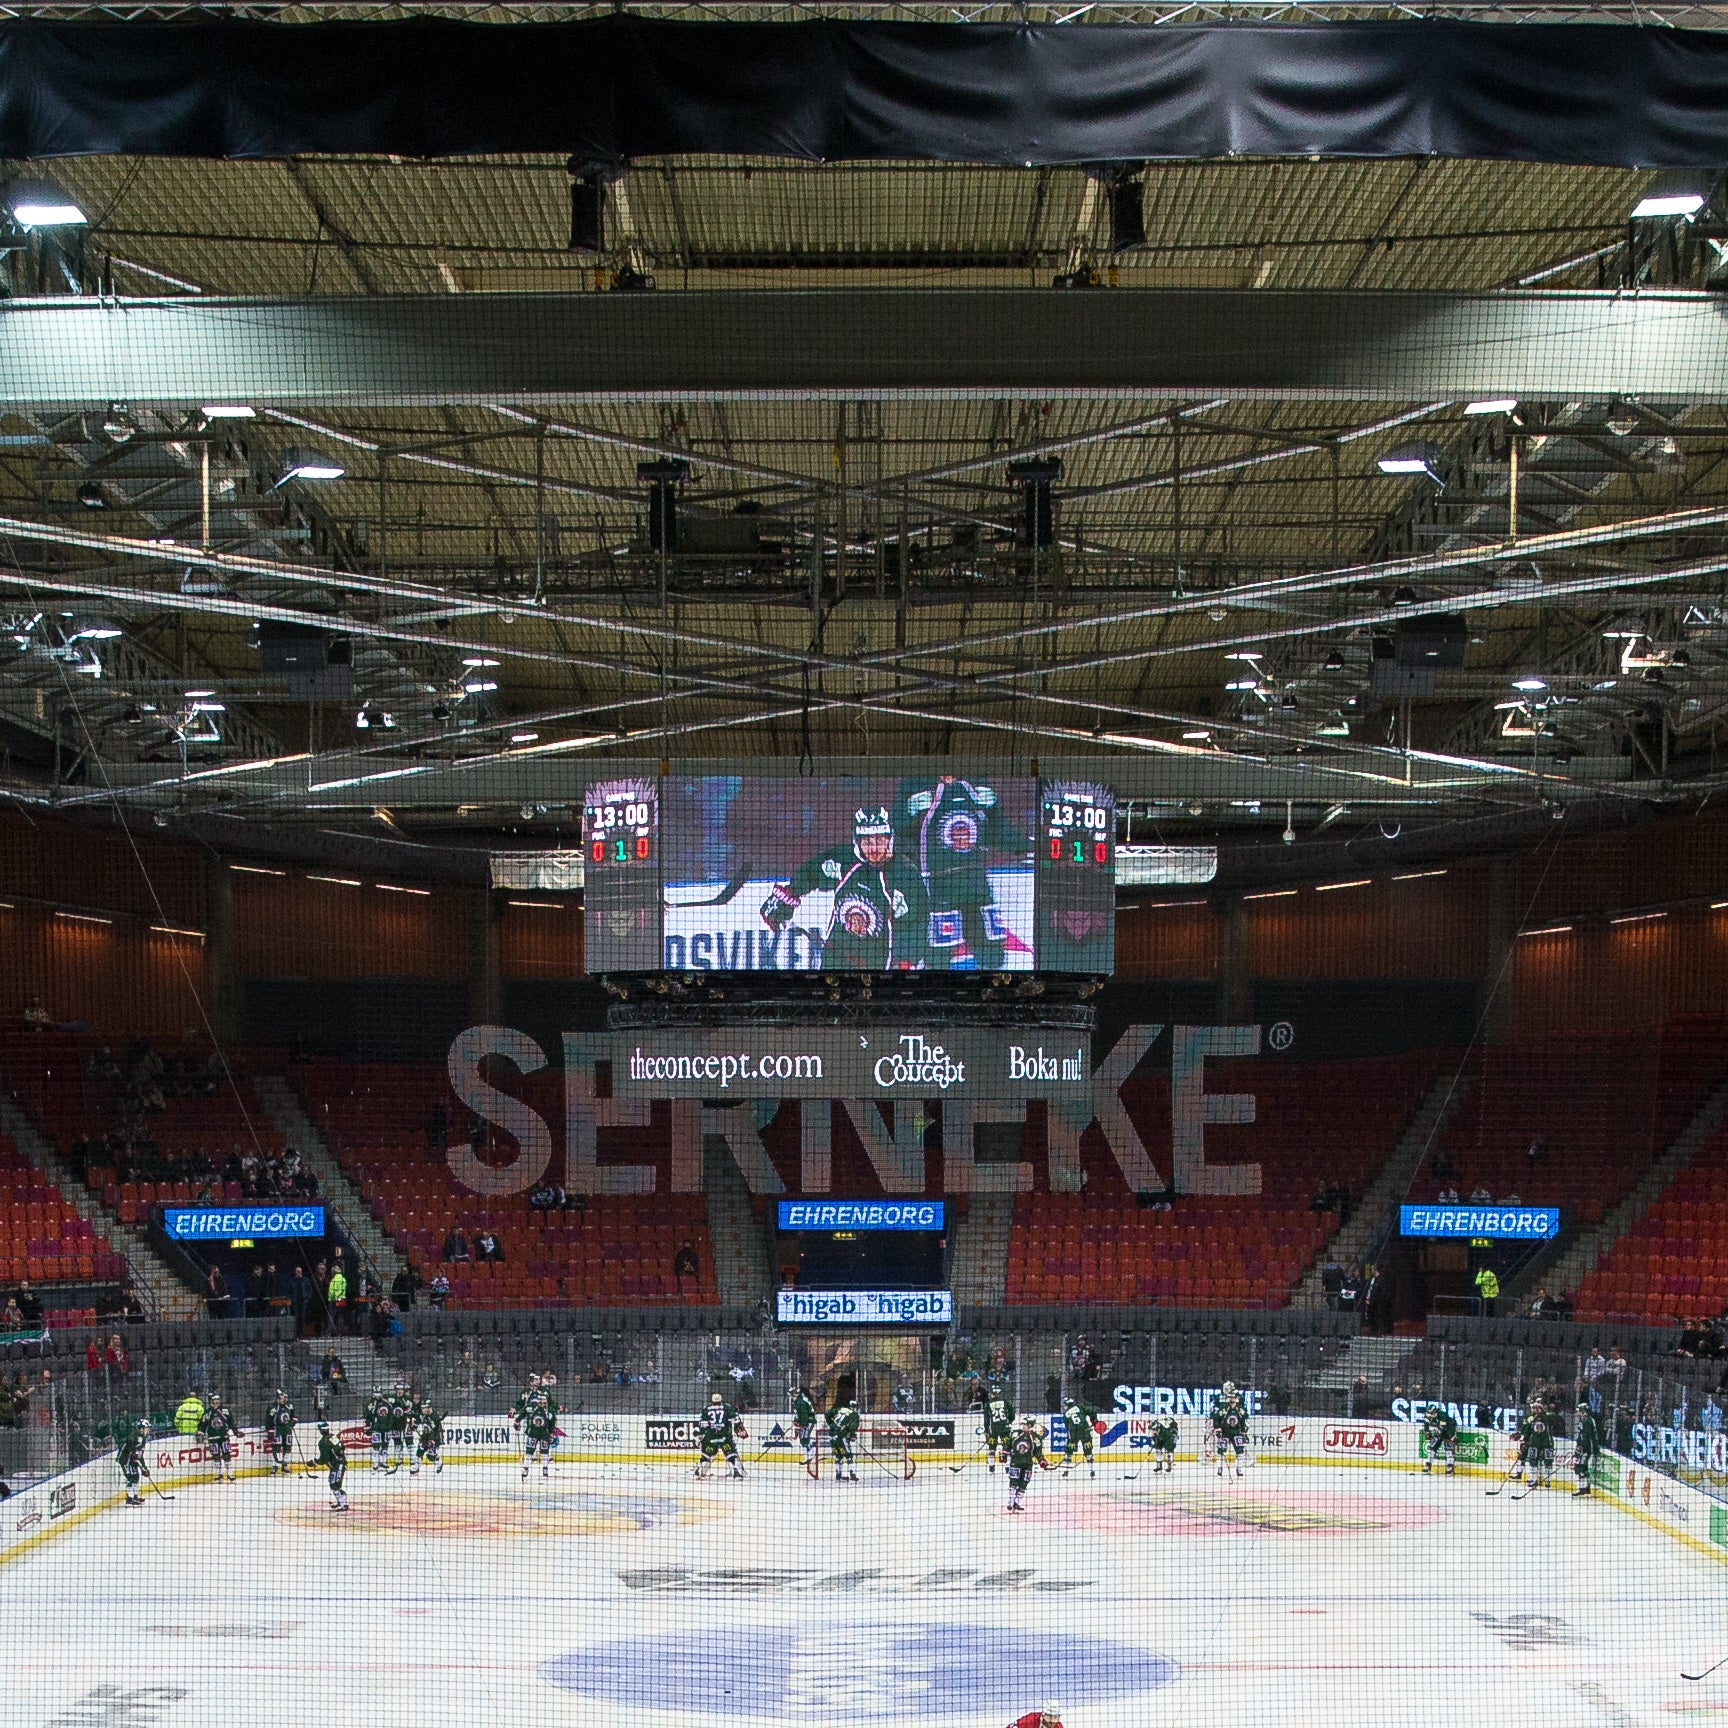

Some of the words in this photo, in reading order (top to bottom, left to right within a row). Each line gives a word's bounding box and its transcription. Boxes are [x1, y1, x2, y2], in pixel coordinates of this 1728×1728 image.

[593, 804, 648, 829] 13:00
[1051, 804, 1106, 829] 13:00
[615, 840, 627, 861] 1
[1073, 841, 1085, 862] 1
[899, 1034, 945, 1064] The
[629, 1046, 823, 1088] theconcept.com
[1009, 1046, 1058, 1080] Boka
[1061, 1048, 1082, 1080] nu!
[175, 1211, 315, 1234] EHRENBORG
[788, 1205, 935, 1225] EHRENBORG
[1410, 1211, 1548, 1233] EHRENBORG
[793, 1293, 856, 1320] higab
[878, 1292, 944, 1320] higab
[707, 1410, 725, 1424] 37
[1325, 1430, 1386, 1451] JULA
